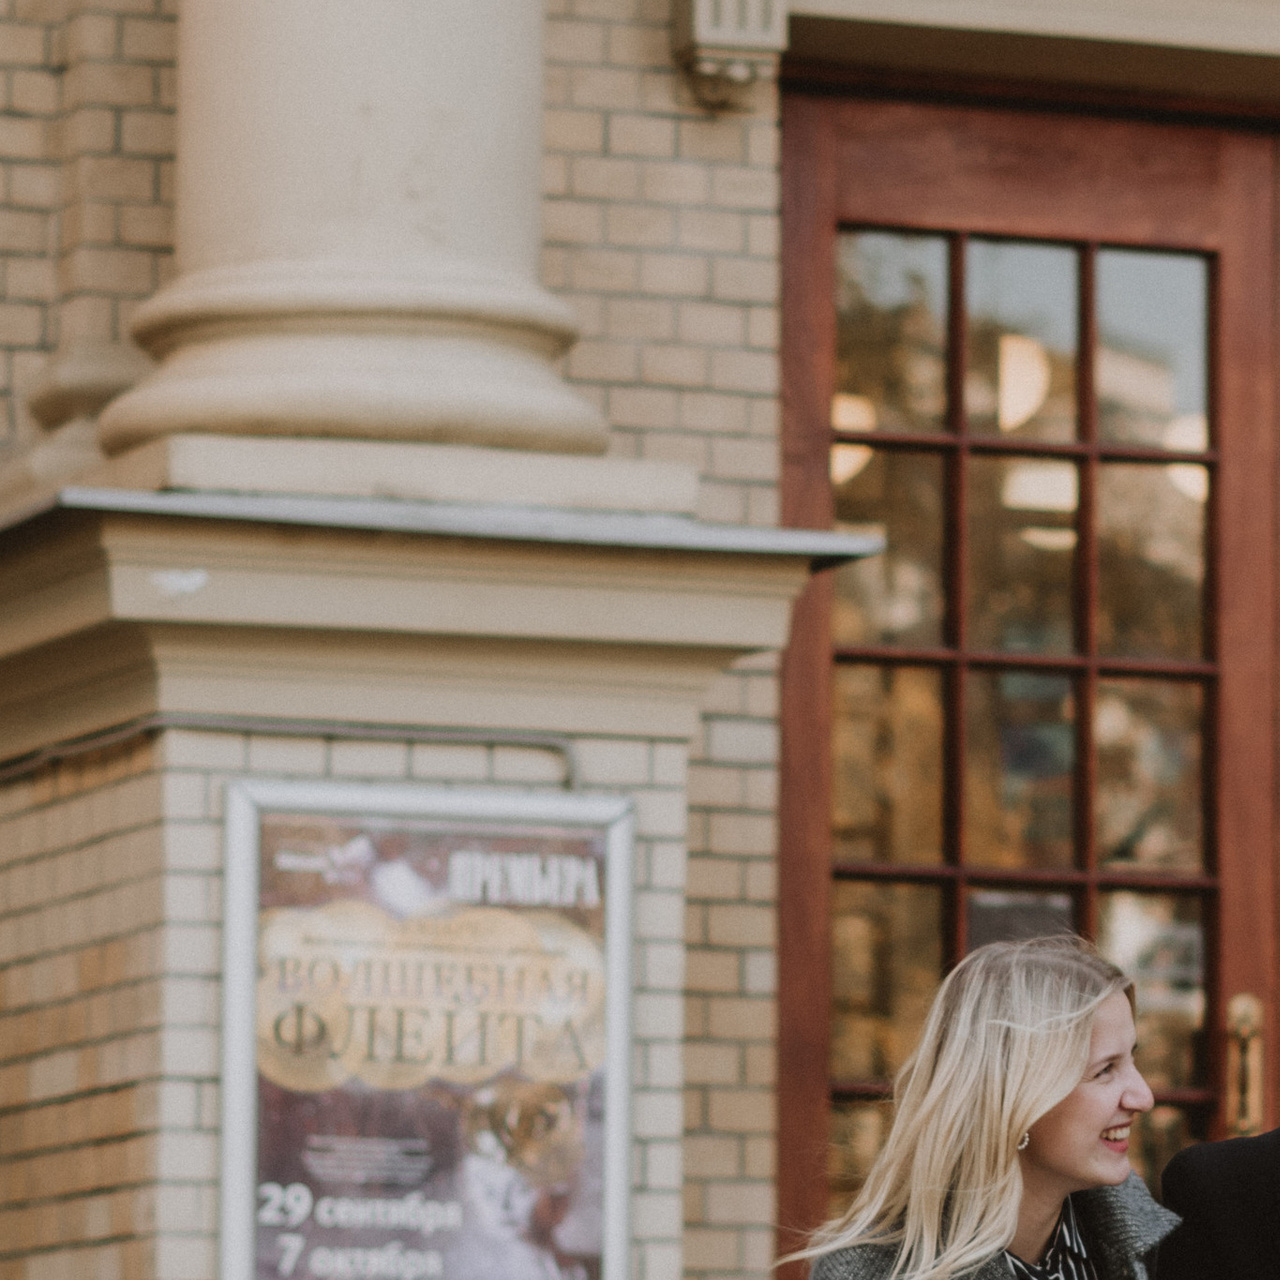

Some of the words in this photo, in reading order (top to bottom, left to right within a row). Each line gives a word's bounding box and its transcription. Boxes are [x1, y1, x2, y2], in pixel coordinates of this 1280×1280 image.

[449, 850, 601, 909] ПРЕМЬЕРА
[277, 956, 589, 1006] ВОЛШЕБНАЯ
[272, 1001, 587, 1071] ФЛЕЙТА
[258, 1181, 313, 1228] 29
[314, 1190, 463, 1238] сентября
[276, 1231, 306, 1278] 7
